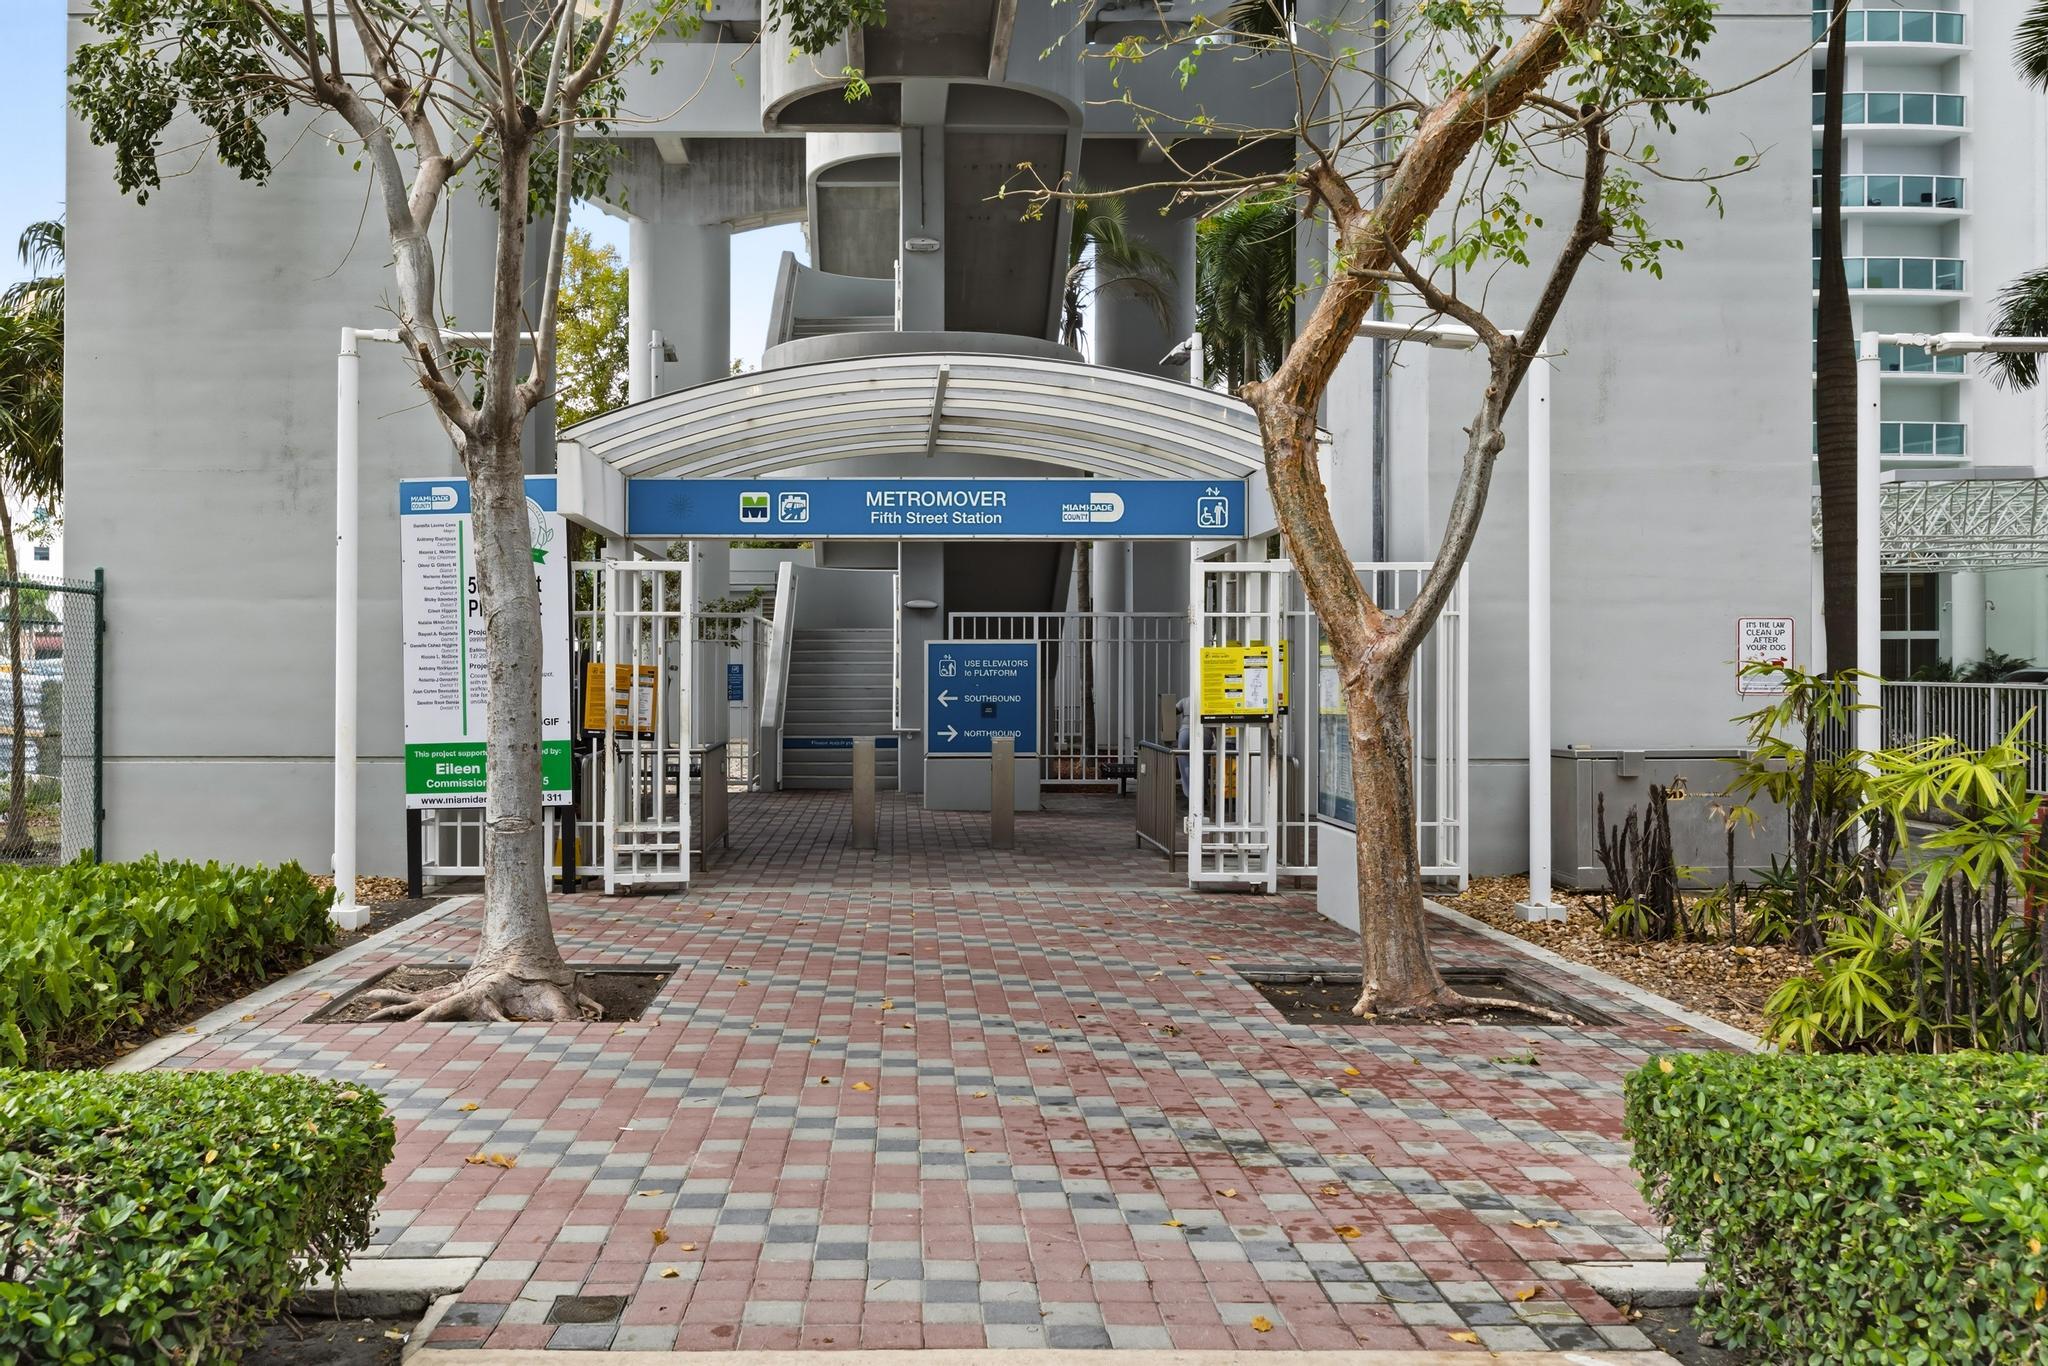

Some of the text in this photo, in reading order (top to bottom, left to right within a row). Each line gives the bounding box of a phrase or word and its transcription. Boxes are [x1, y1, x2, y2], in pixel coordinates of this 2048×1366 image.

[866, 491, 1006, 506] METROMOVER
[871, 511, 1002, 524] Fifth Street Station
[1063, 513, 1088, 521] COUNTY
[974, 669, 1017, 677] PLATFORM
[964, 695, 1021, 703] SOUTHBOUND
[431, 750, 456, 758] project
[436, 763, 480, 775] Eileen
[543, 777, 549, 785] 5
[547, 793, 562, 801] 311
